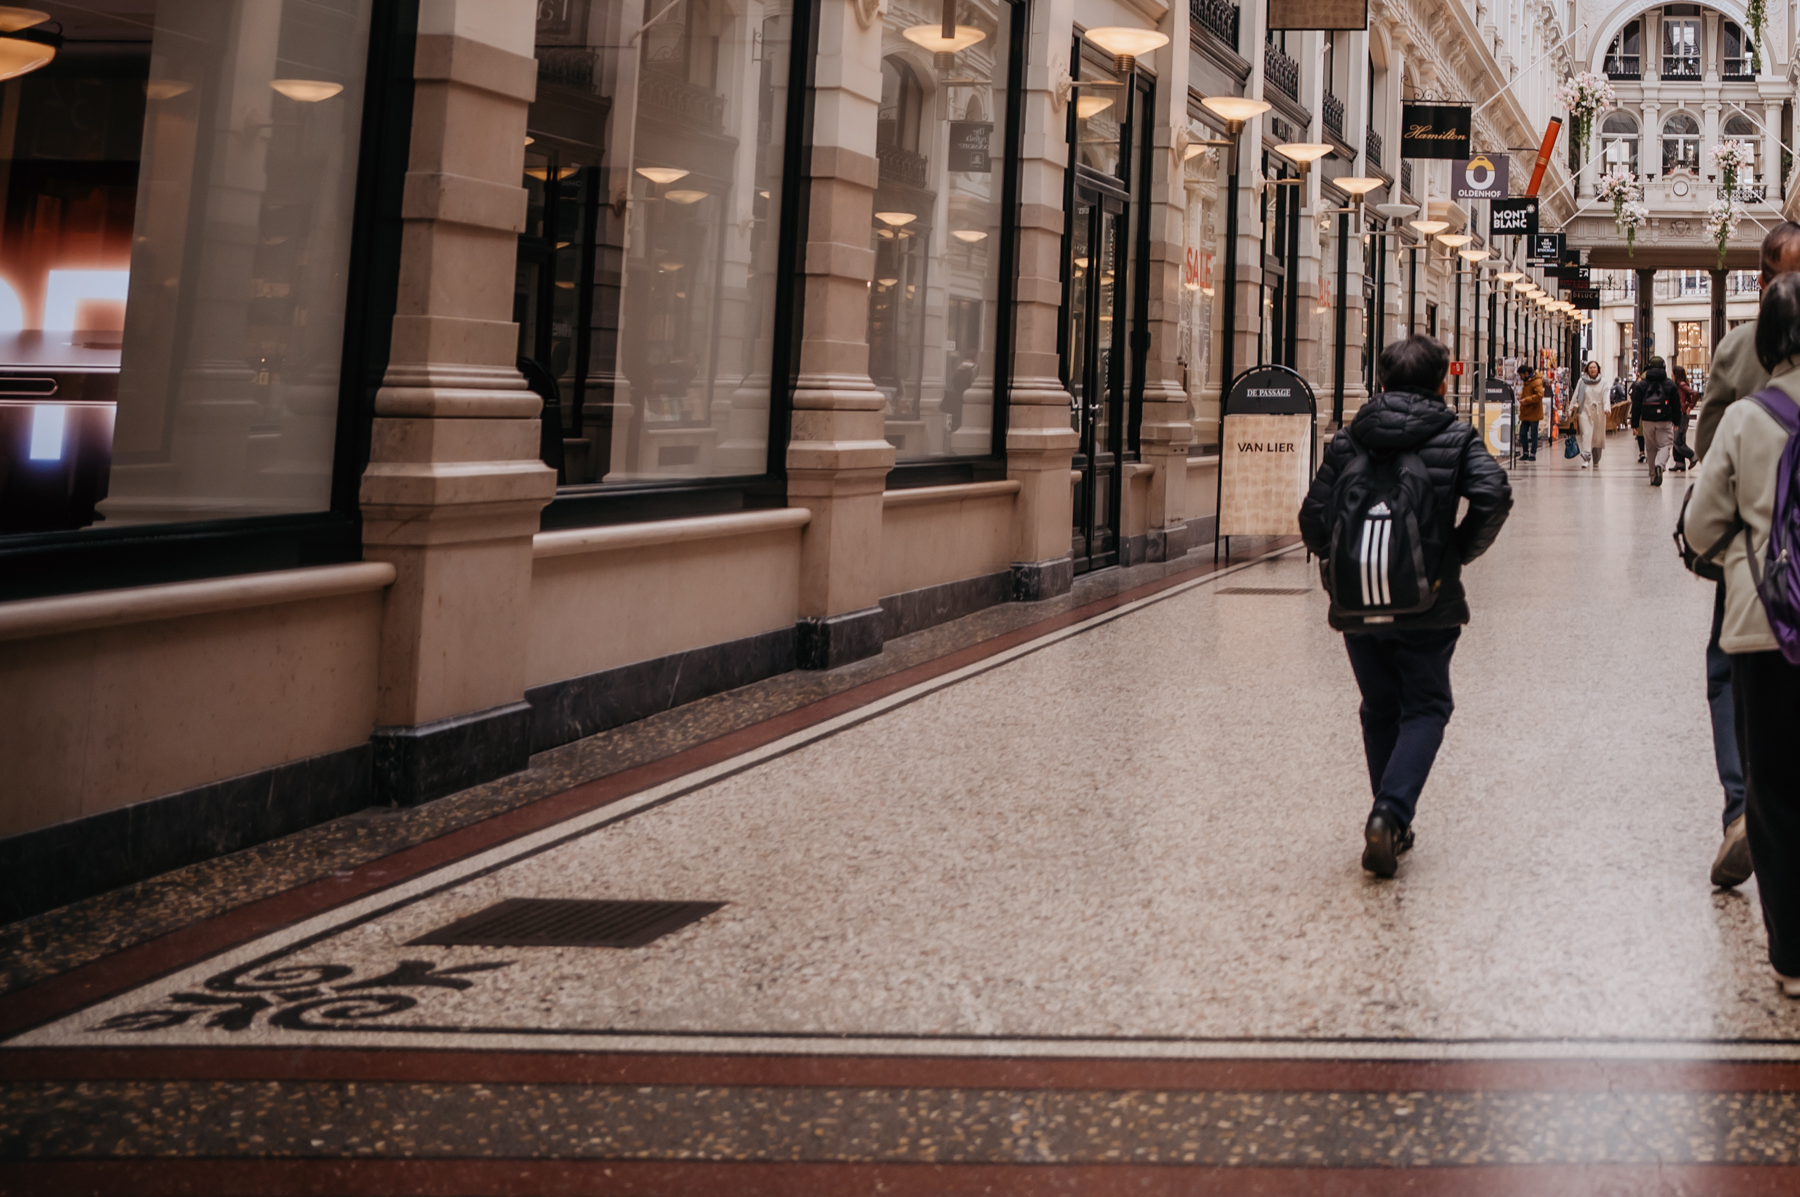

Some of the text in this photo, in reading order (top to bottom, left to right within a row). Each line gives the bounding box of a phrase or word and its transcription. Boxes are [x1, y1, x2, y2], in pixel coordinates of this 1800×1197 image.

[1404, 125, 1467, 140] Hamilton
[1458, 189, 1501, 198] OLDENHOF
[1493, 210, 1527, 219] MONT
[1493, 219, 1527, 228] BLANC
[1186, 247, 1212, 289] SALE
[1247, 388, 1291, 397] DE PASSAGE
[1237, 443, 1294, 452] VAN LIER
